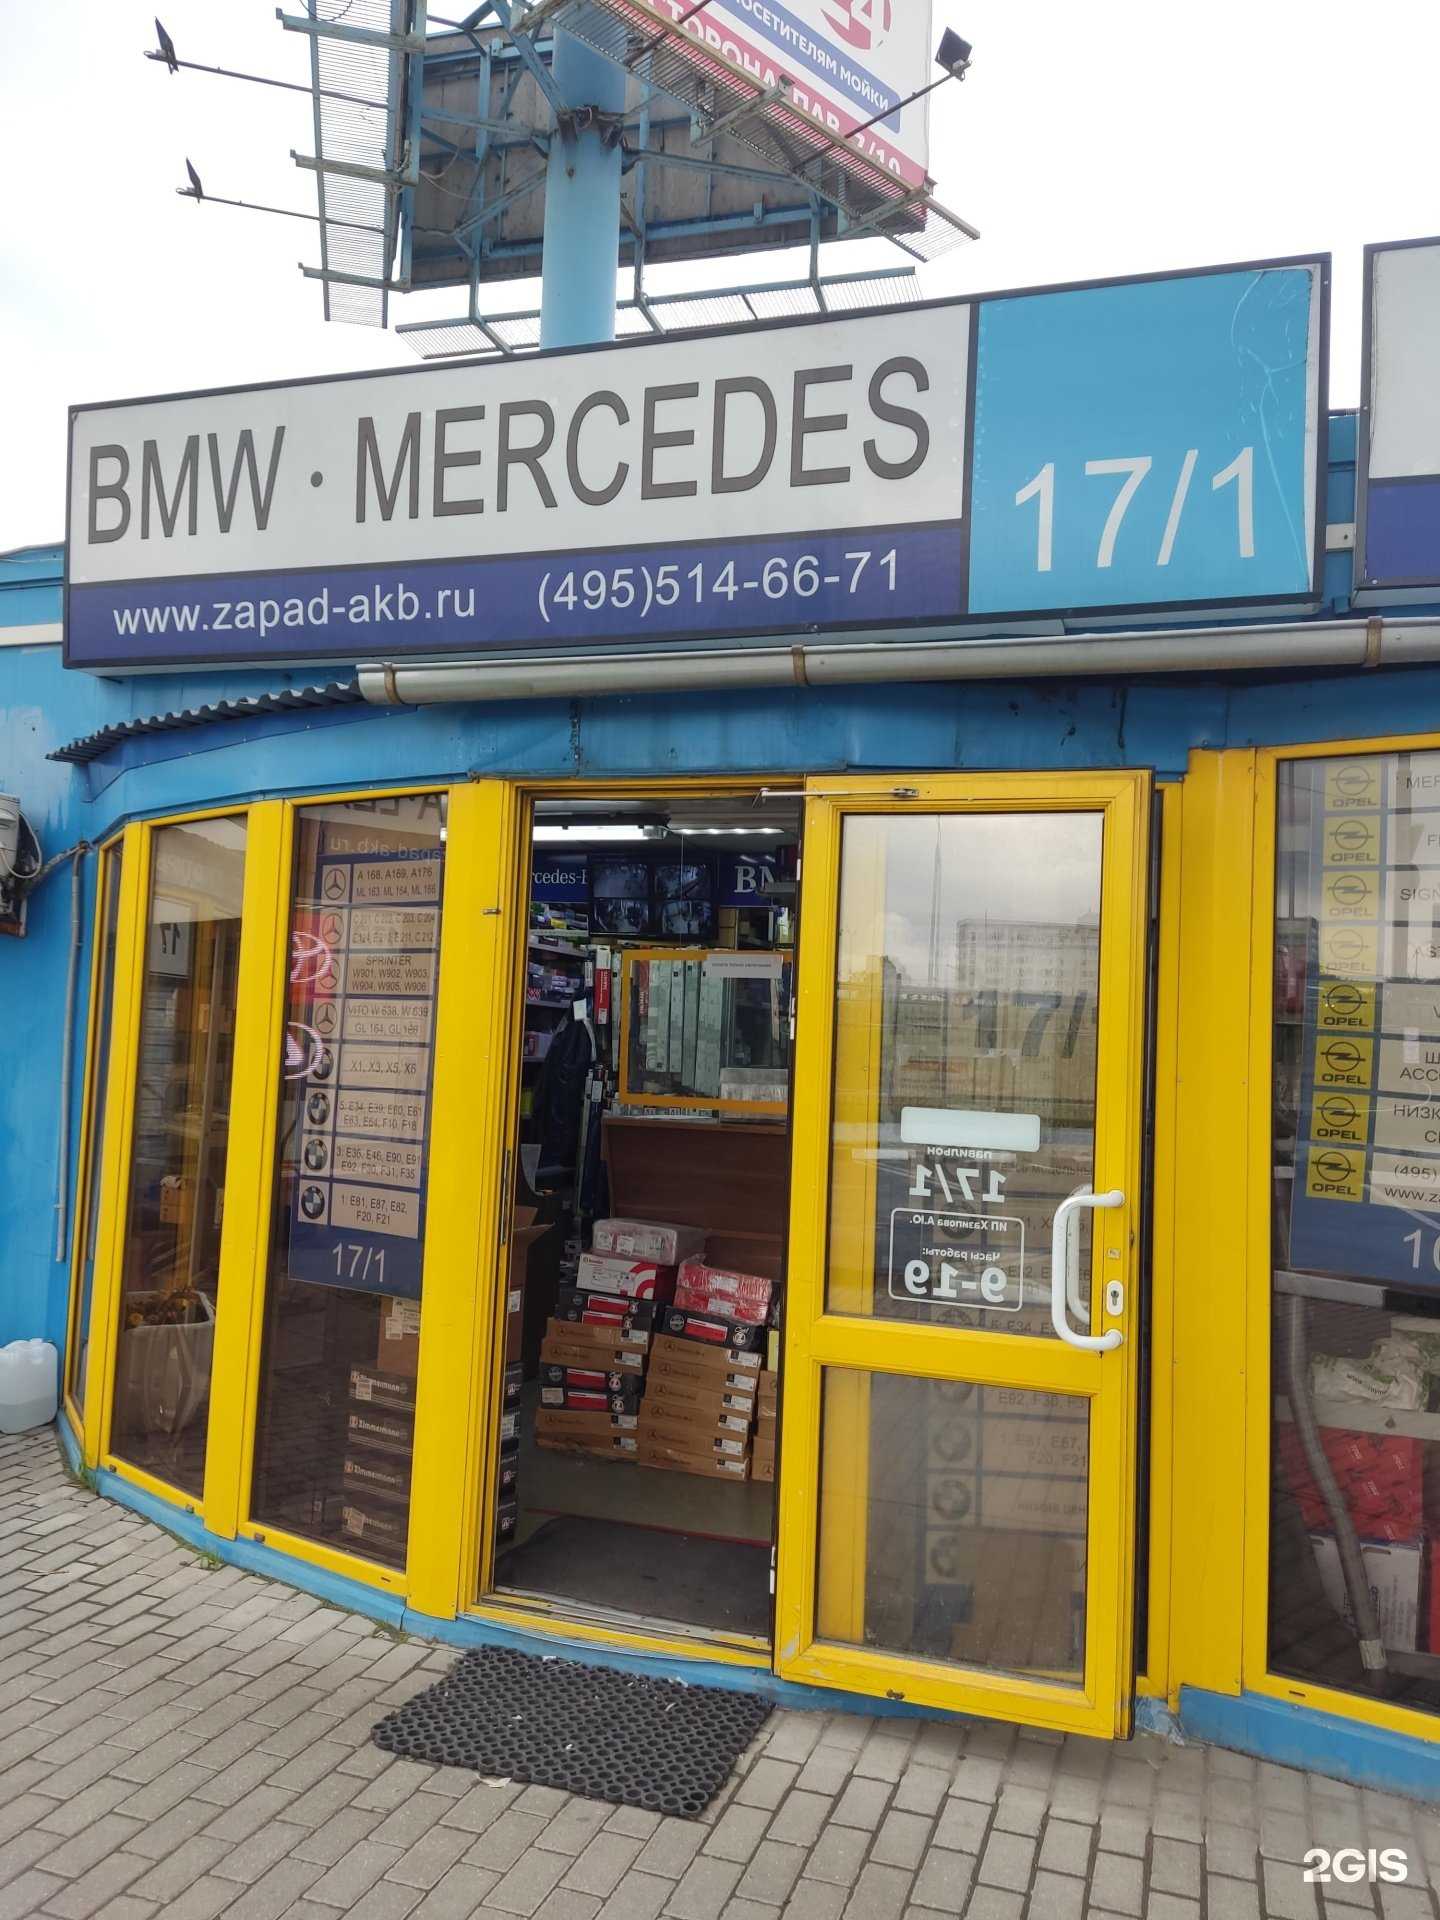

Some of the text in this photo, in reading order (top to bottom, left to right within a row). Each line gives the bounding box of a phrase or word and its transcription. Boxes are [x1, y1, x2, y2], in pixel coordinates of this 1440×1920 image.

[737, 0, 889, 111] ОСЕТИТЕЛЯМ МОЙКИ
[87, 356, 931, 545] BMW MERCEDES
[1015, 446, 1255, 572] 17/1
[113, 548, 898, 638] www.zapad-akb.ru (495)514-66-71
[1332, 798, 1377, 808] OPEL
[1330, 852, 1376, 862] OPEL
[1328, 907, 1374, 917] OPEL
[366, 955, 412, 967] SPRINTER
[1326, 961, 1372, 972] OPEL
[1324, 1015, 1368, 1027] OPEL
[1322, 1073, 1367, 1085] OPEL
[1316, 1128, 1362, 1141] OPEL
[1312, 1183, 1357, 1196] OPEL
[370, 1198, 388, 1212] E87,
[356, 1210, 391, 1225] F20, F21
[332, 1242, 385, 1283] 17/1
